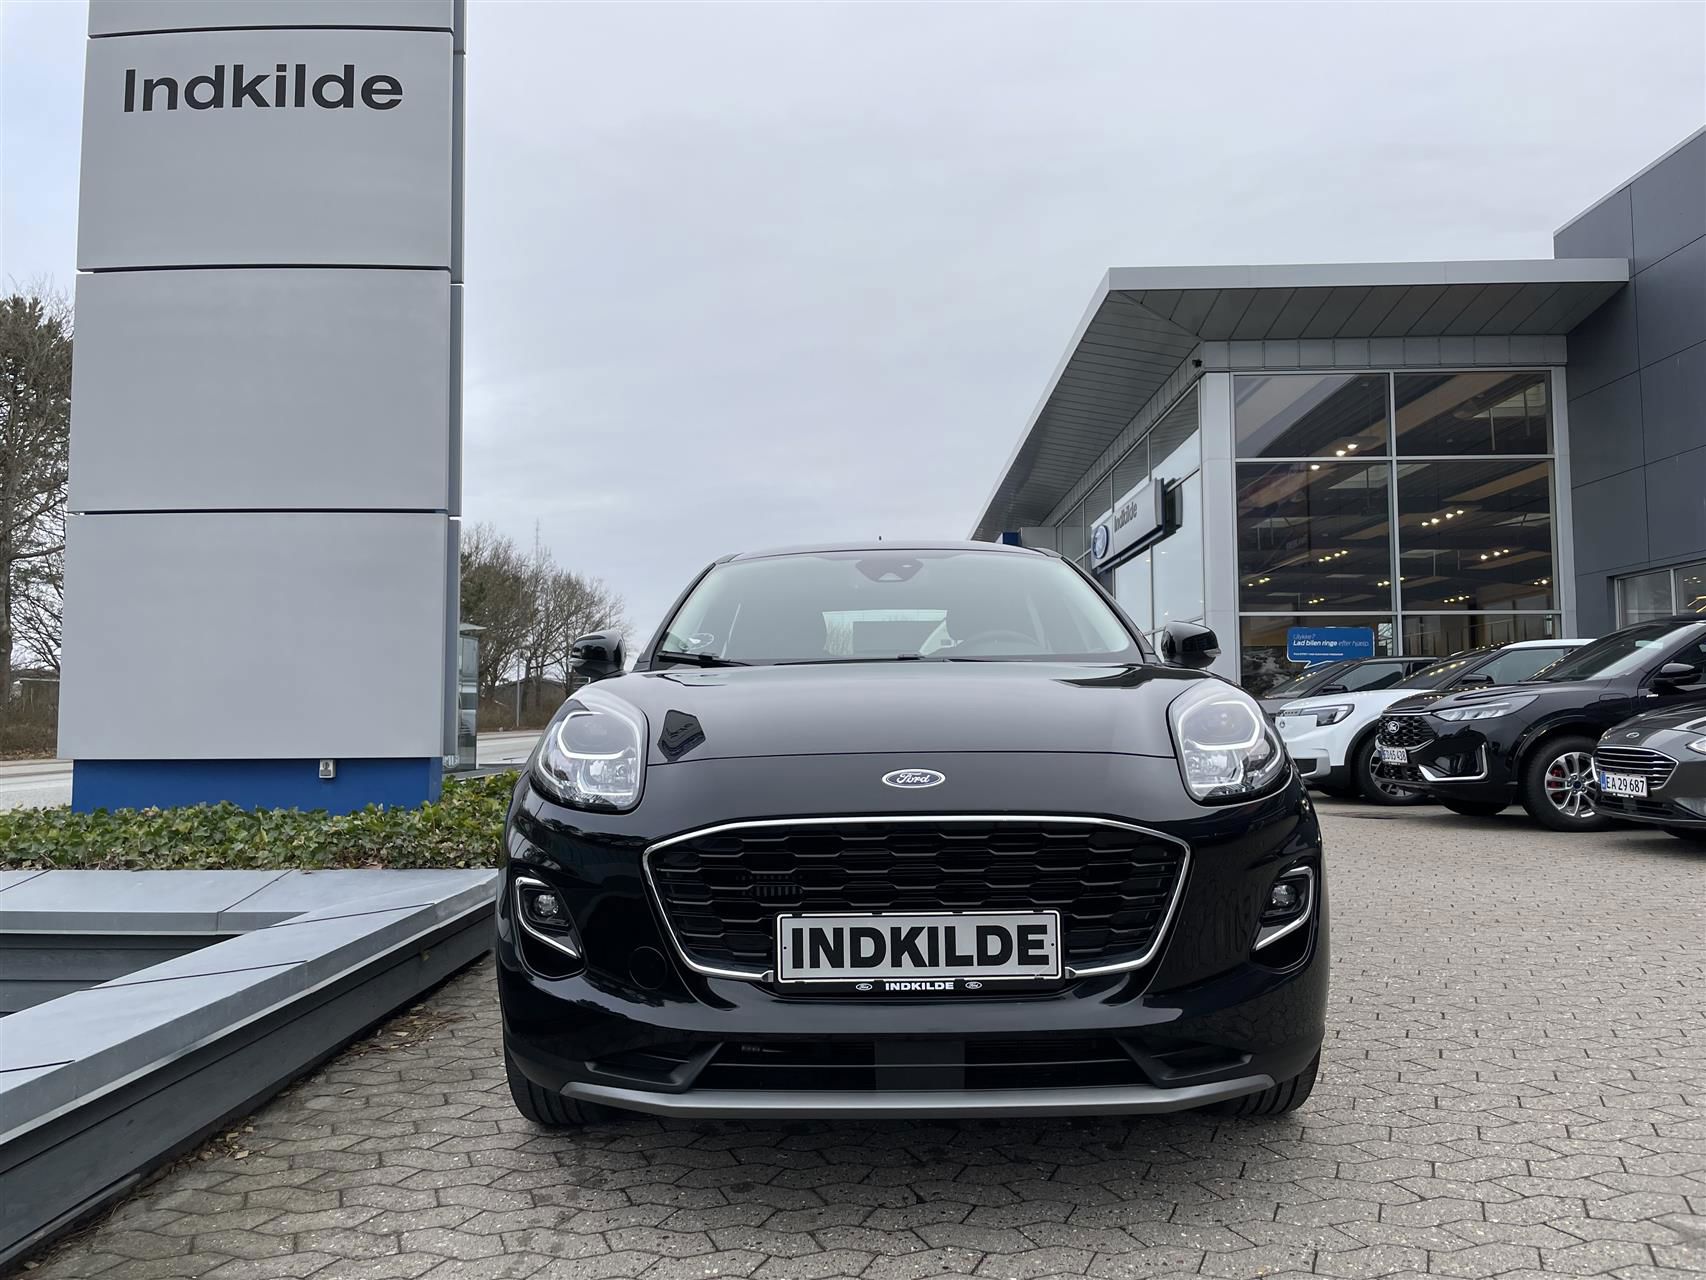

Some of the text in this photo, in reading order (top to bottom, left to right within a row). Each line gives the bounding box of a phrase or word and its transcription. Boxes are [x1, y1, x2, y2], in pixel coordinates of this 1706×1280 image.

[123, 63, 403, 113] Indkilde
[1114, 501, 1138, 533] Indkilde
[1322, 639, 1337, 647] ringe
[896, 771, 931, 784] Ford
[1606, 776, 1645, 793] EA 29 687
[791, 924, 1050, 970] INDKILDE
[885, 982, 954, 991] INDKILDE
